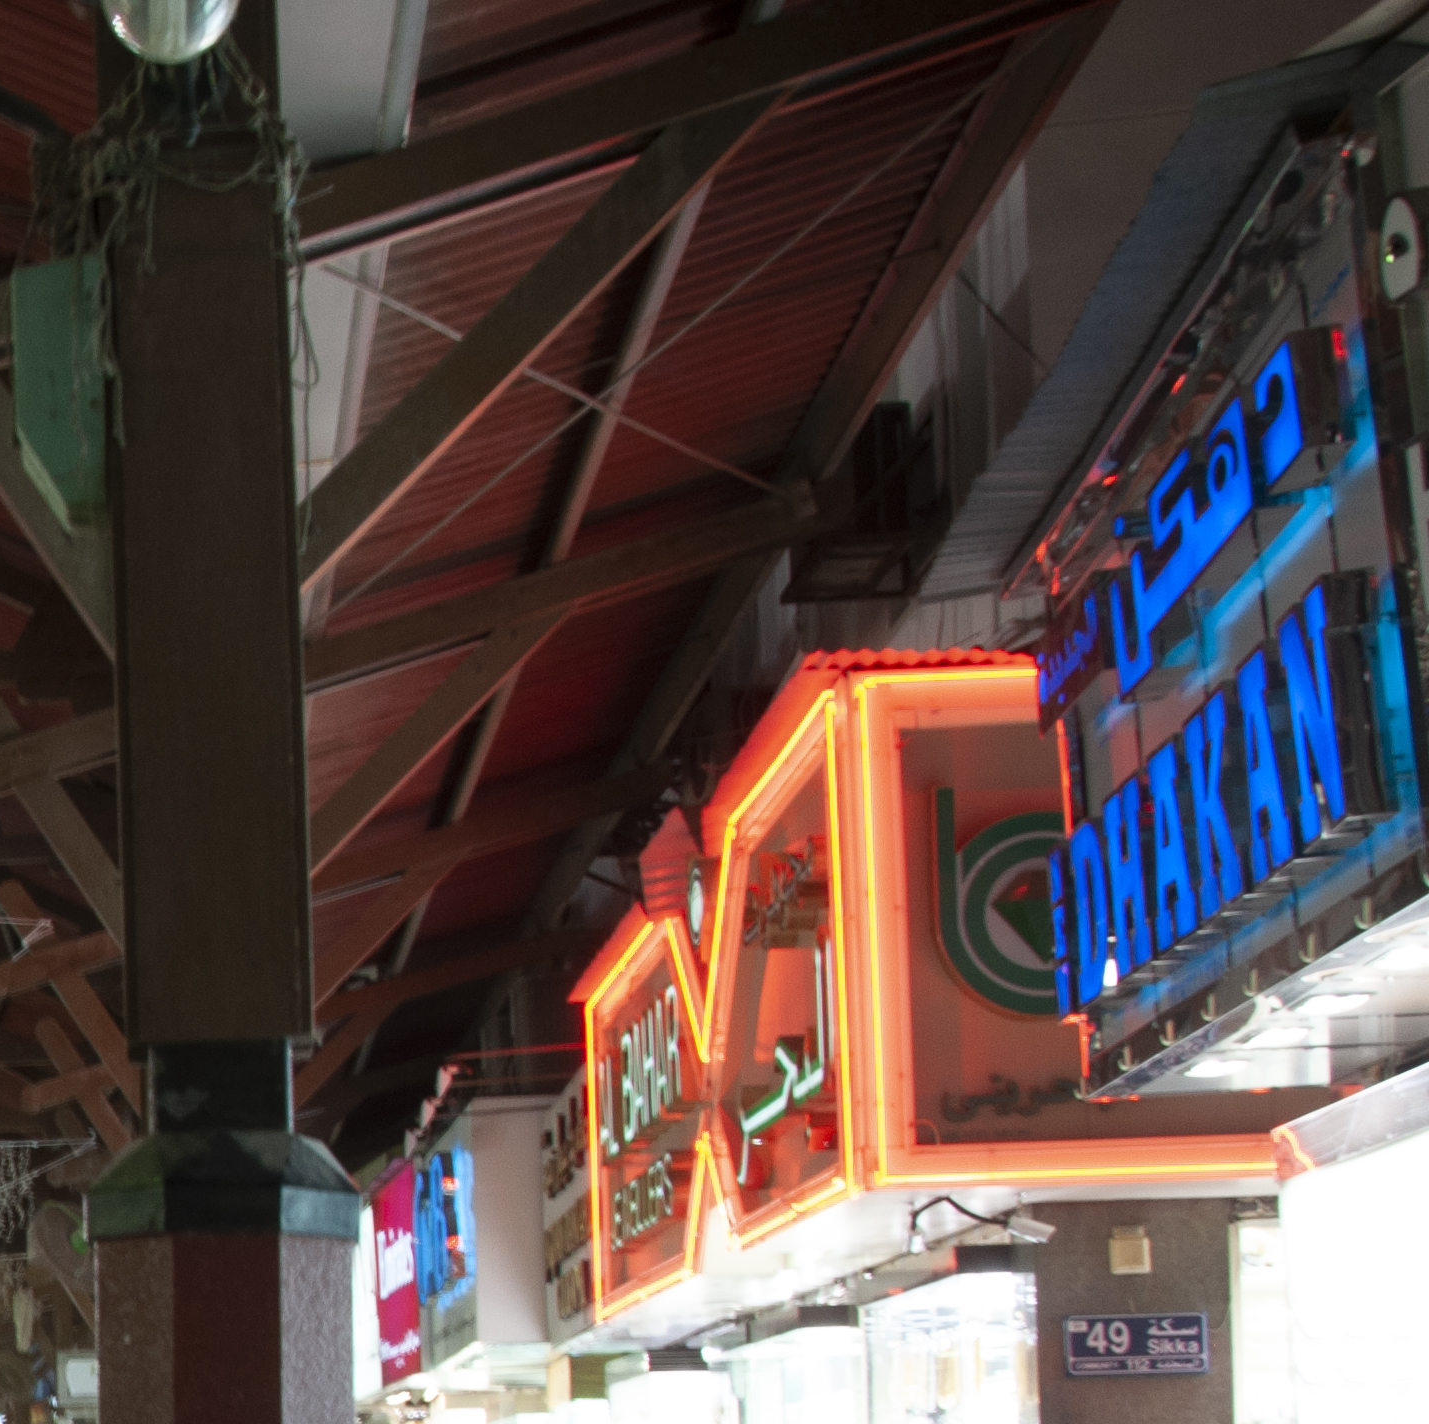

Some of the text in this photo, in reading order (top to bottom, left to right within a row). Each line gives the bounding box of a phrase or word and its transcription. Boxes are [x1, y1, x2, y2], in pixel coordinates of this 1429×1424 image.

[1070, 583, 1346, 1007] DHAKAN
[1086, 1320, 1131, 1355] 49
[1146, 1338, 1200, 1355] Sikka
